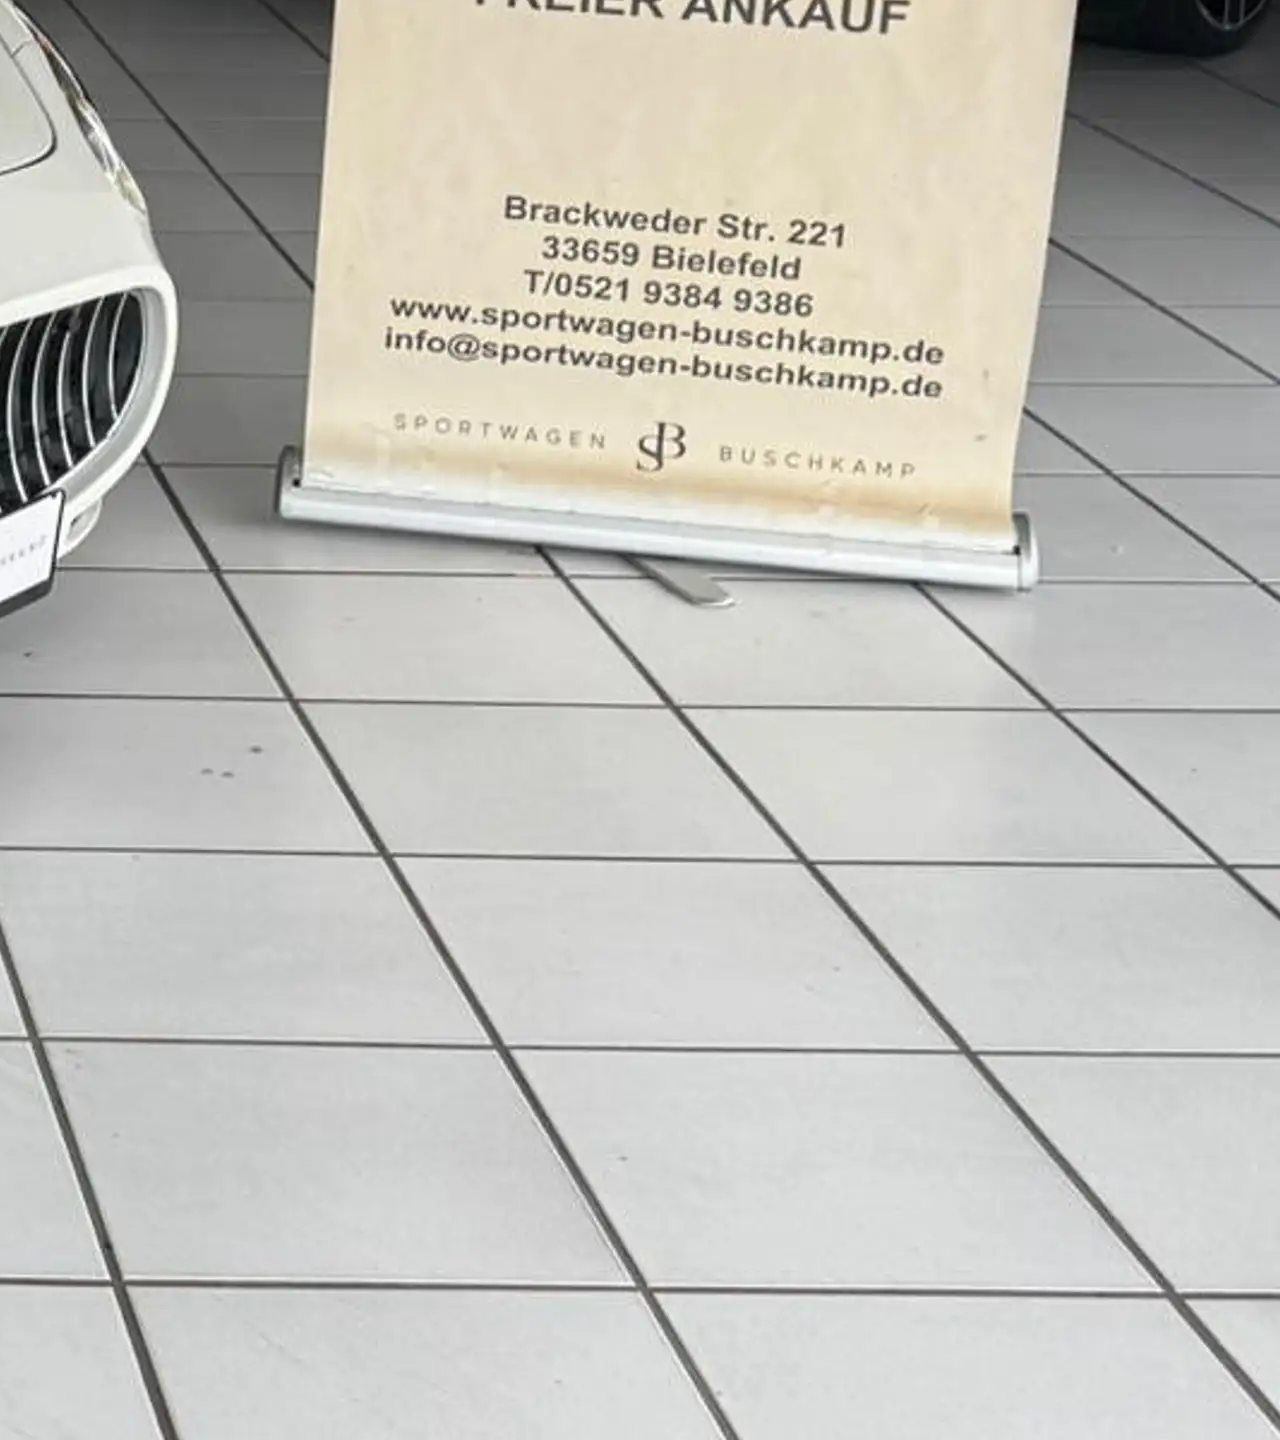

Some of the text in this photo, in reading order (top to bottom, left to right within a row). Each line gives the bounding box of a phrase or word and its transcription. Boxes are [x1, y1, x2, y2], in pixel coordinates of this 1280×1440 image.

[503, 194, 847, 249] Brackweder Str. 221
[540, 233, 803, 282] 33659 Bielefeld
[522, 268, 814, 319] T/0521 9384 9386
[383, 325, 944, 400] info@sportwagen-buschkamp.de
[389, 297, 946, 367] www.sportwagen-buschkamp.de
[393, 412, 606, 451] SPORTWAGEN
[718, 444, 916, 479] BUSCHKAMP
